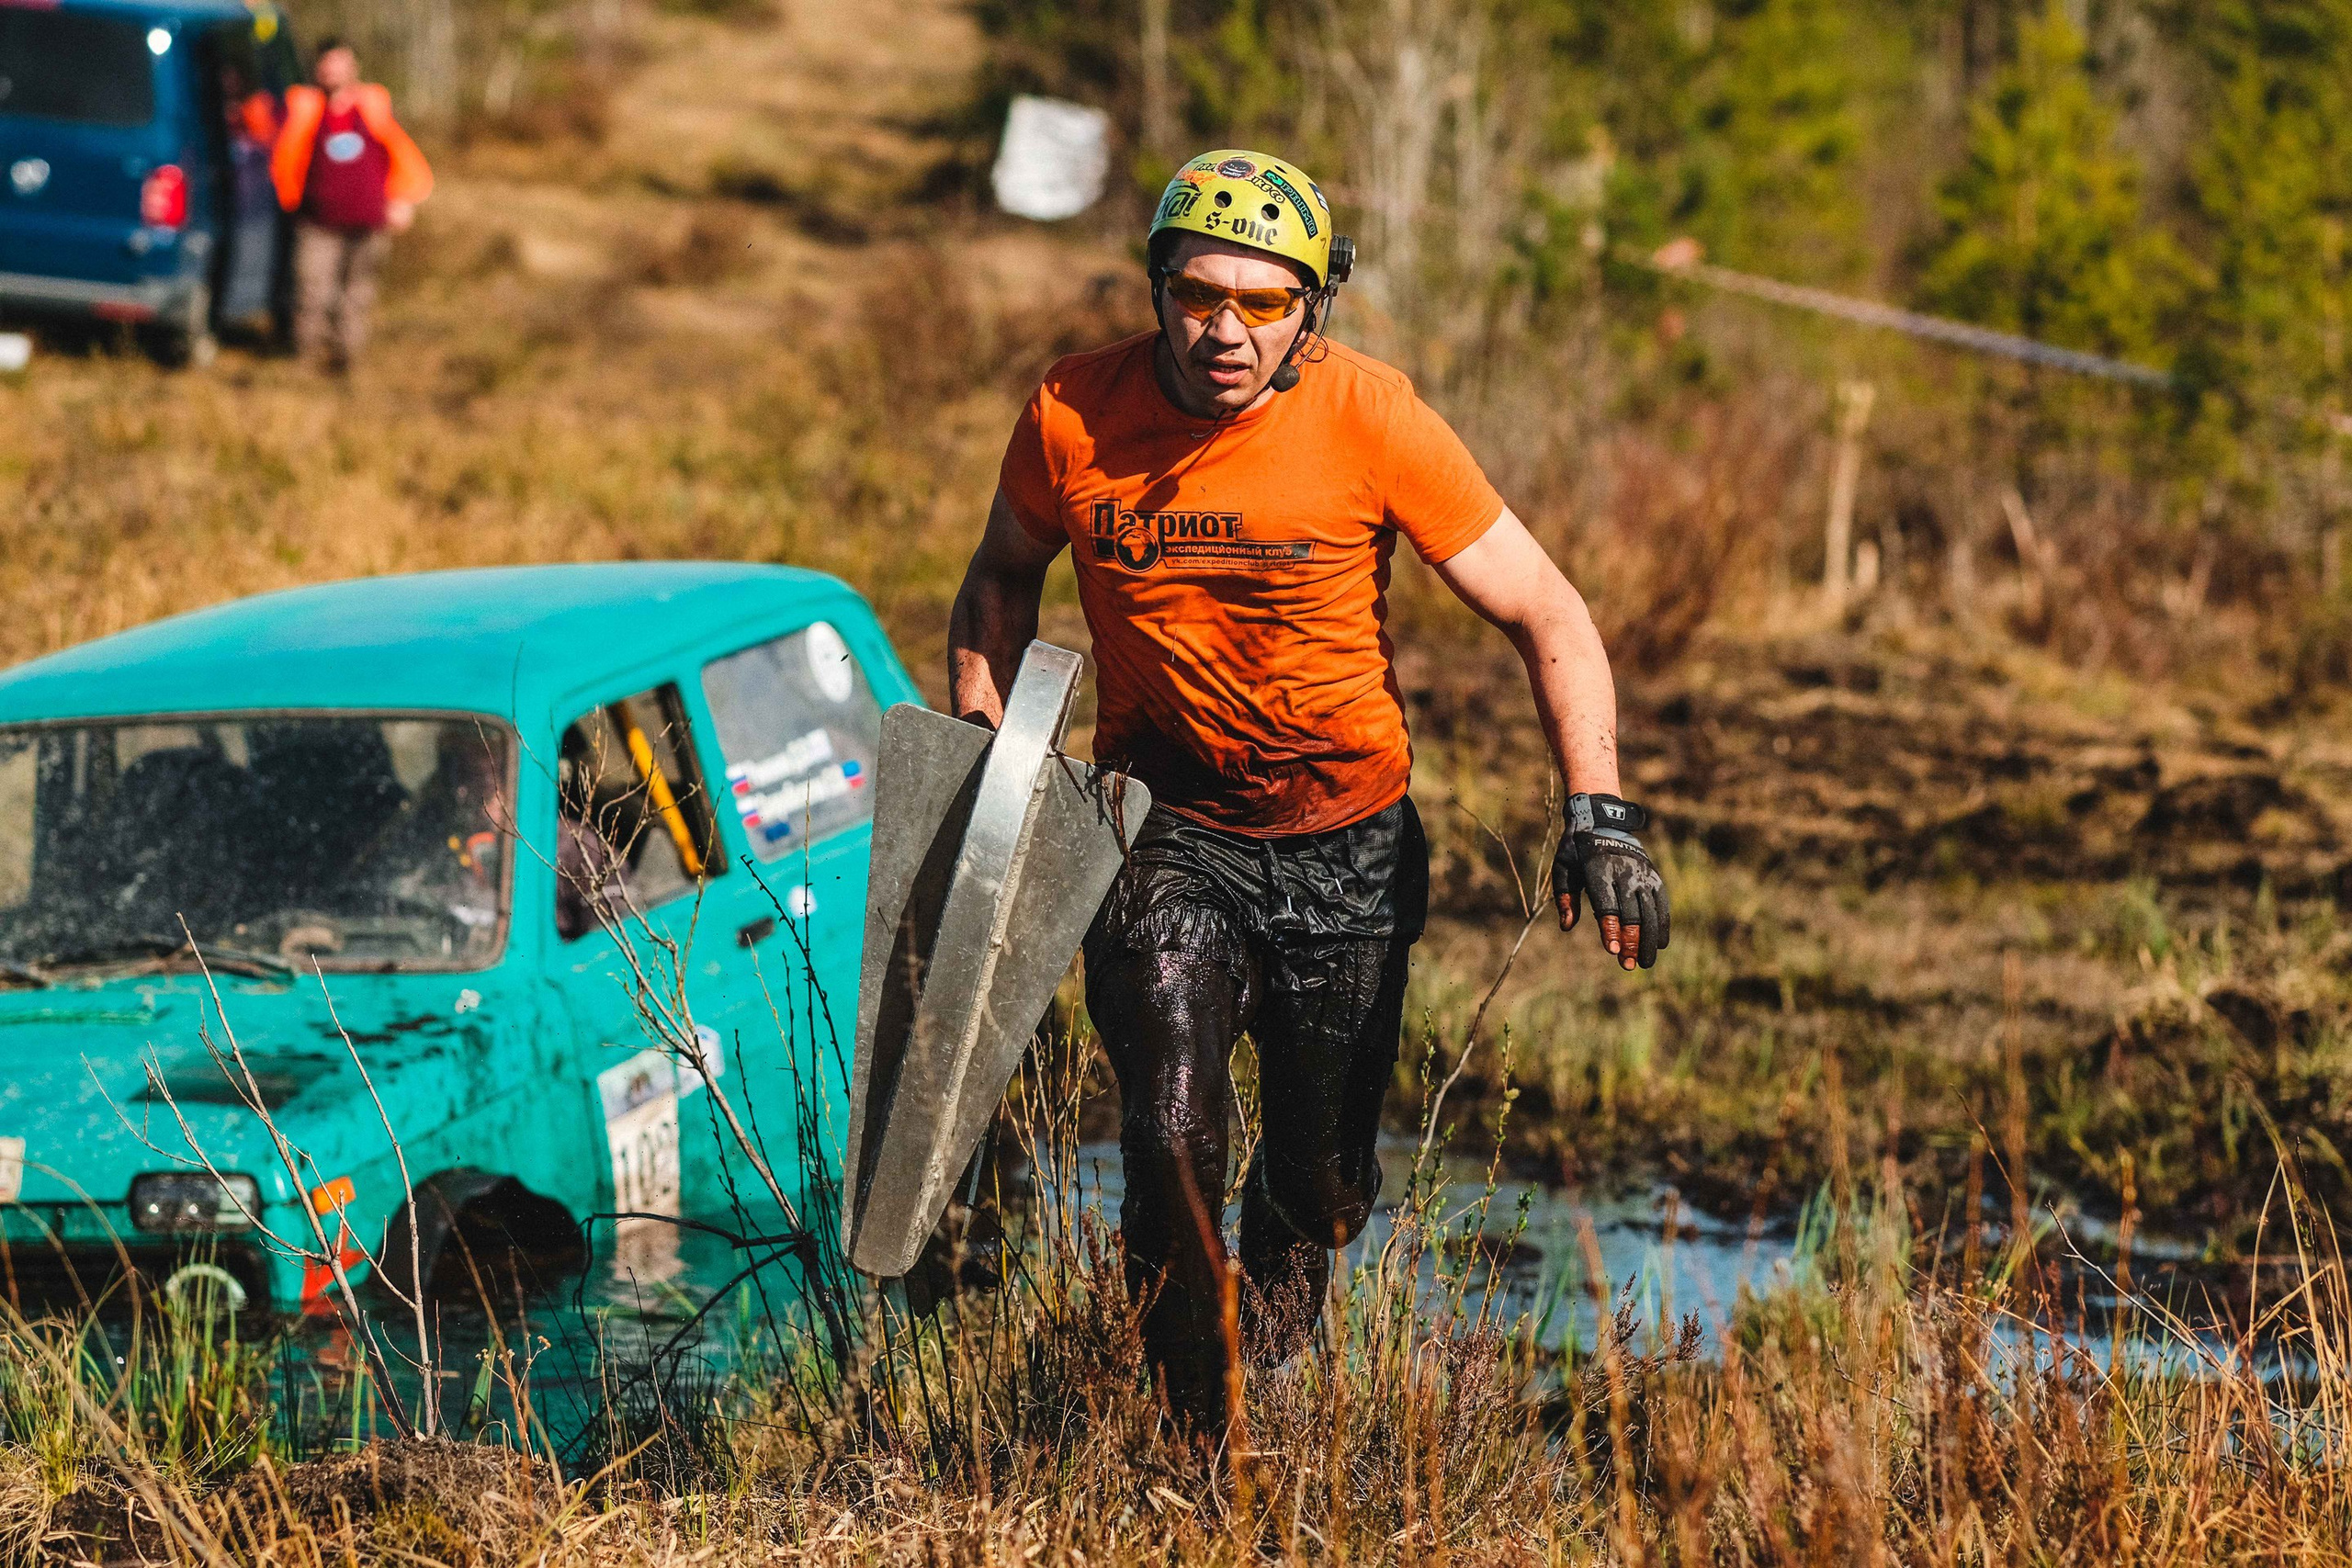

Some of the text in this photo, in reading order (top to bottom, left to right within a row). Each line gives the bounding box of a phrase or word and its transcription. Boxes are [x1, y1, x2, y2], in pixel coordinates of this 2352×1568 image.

[1280, 183, 1317, 236] PRIMO
[1093, 502, 1238, 550] Патриот
[1165, 544, 1293, 558] экспедиционный клуб
[1603, 805, 1624, 818] FT
